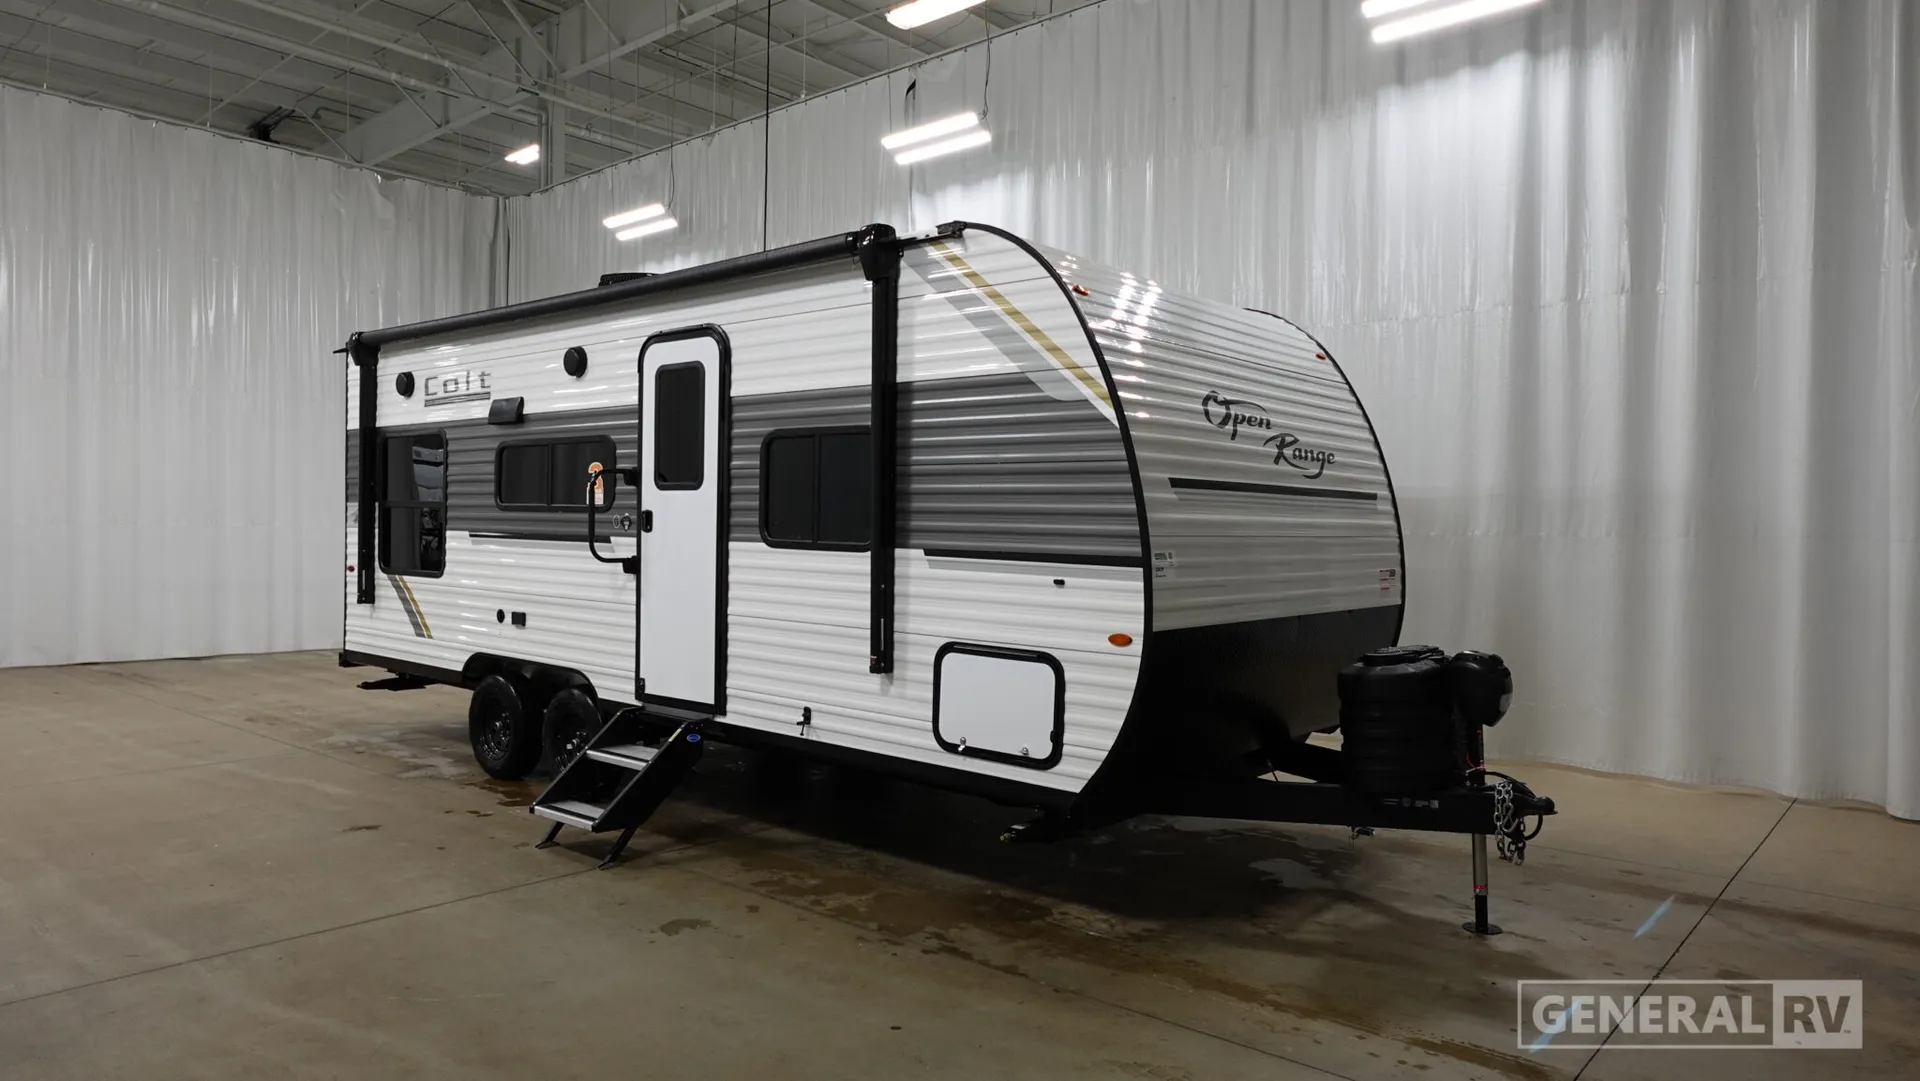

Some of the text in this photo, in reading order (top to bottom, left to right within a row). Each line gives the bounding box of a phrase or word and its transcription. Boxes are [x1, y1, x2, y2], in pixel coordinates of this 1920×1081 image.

[425, 370, 491, 396] Colt
[1201, 390, 1273, 441] Open
[1263, 432, 1337, 479] Range
